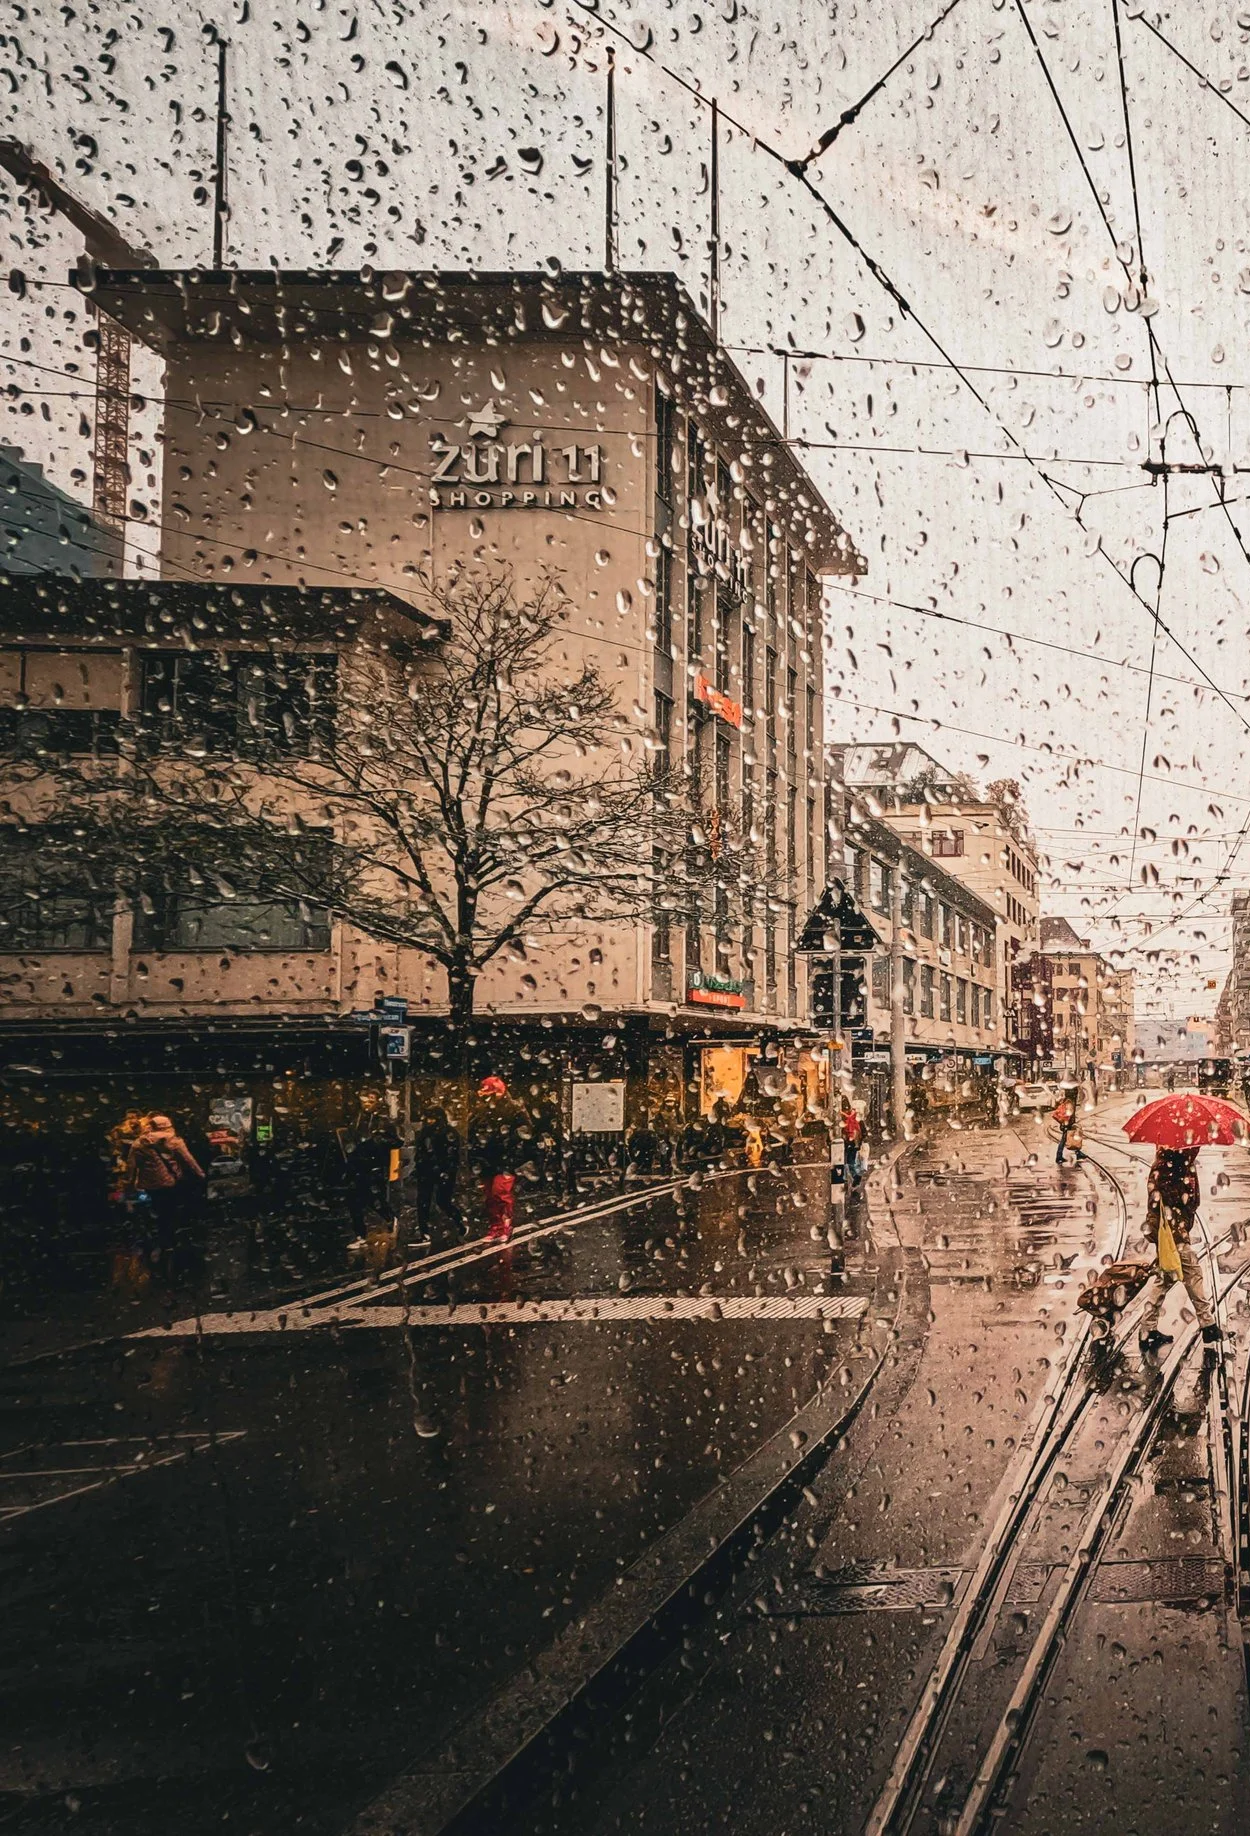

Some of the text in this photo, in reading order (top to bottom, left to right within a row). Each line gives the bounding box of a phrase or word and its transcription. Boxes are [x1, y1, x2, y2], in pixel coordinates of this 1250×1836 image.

[562, 444, 600, 482] 11
[430, 490, 600, 508] SHOPPING
[691, 536, 748, 604] SHOING
